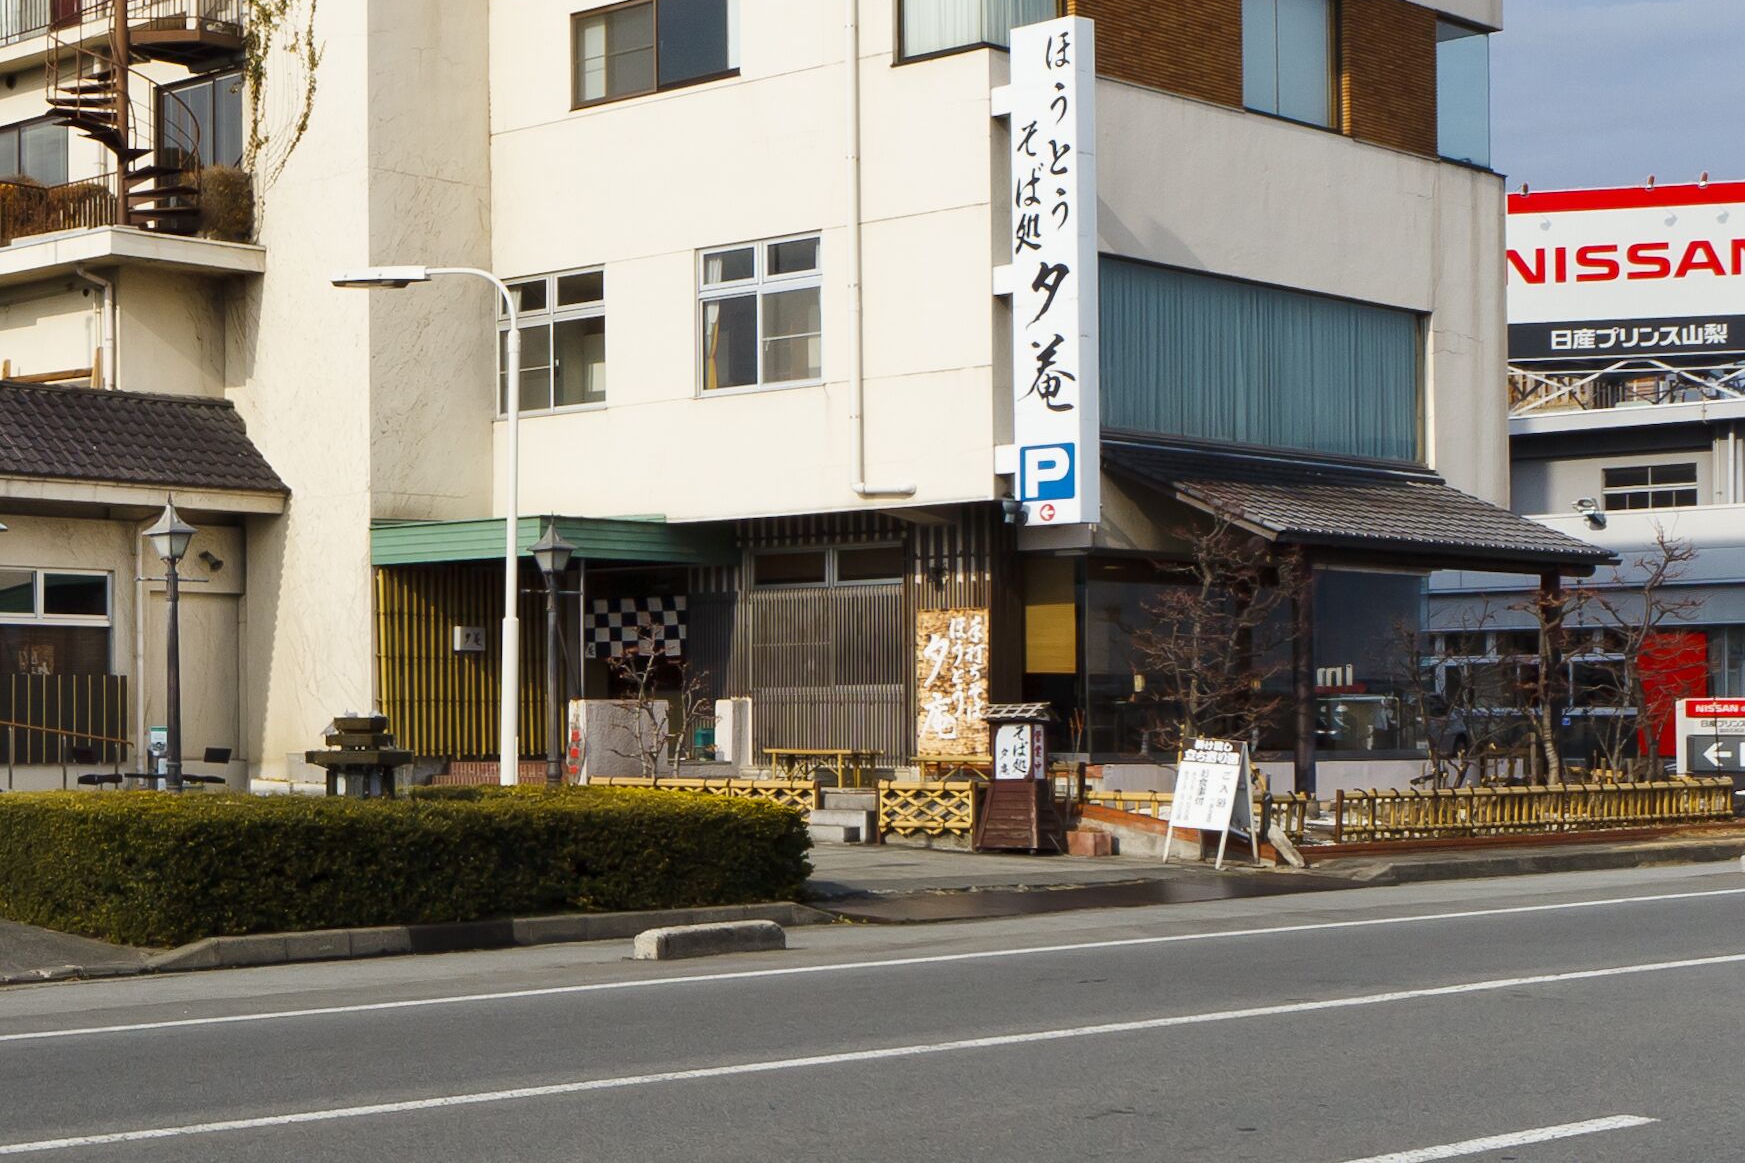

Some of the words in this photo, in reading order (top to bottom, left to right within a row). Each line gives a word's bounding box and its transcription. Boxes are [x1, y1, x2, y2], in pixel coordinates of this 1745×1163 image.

[1045, 30, 1072, 231] ほうとう
[1015, 120, 1044, 255] そば処
[1551, 323, 1728, 350] 日産プリンス山梨
[1025, 447, 1070, 499] P
[1695, 703, 1739, 713] NISSAN
[1013, 725, 1027, 774] そば処
